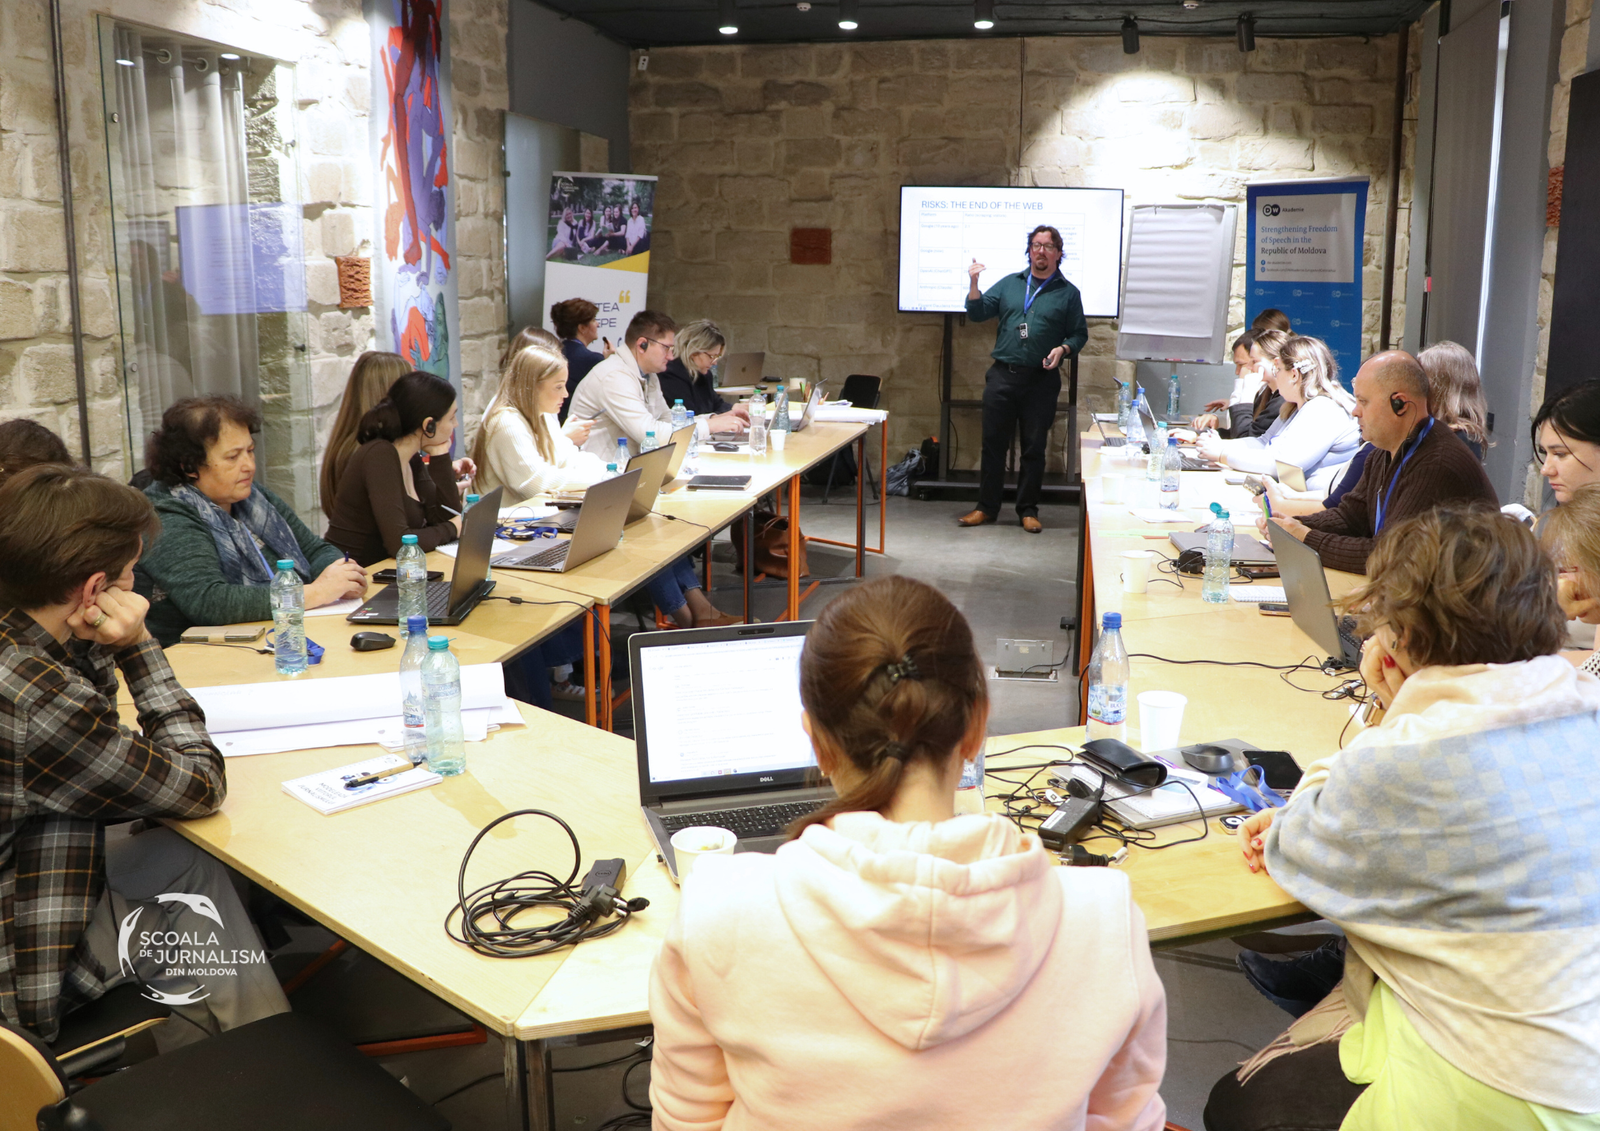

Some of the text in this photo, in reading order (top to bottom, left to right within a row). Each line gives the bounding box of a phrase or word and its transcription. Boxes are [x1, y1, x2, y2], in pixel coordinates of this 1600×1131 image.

[921, 200, 1044, 210] RISKS: THE END OF THE WEB
[1262, 204, 1281, 217] DW
[1261, 225, 1338, 234] Strengthening Freedom
[1261, 236, 1268, 244] of
[1269, 236, 1291, 246] Speech
[1261, 247, 1288, 256] Republic
[594, 302, 620, 312] TEA
